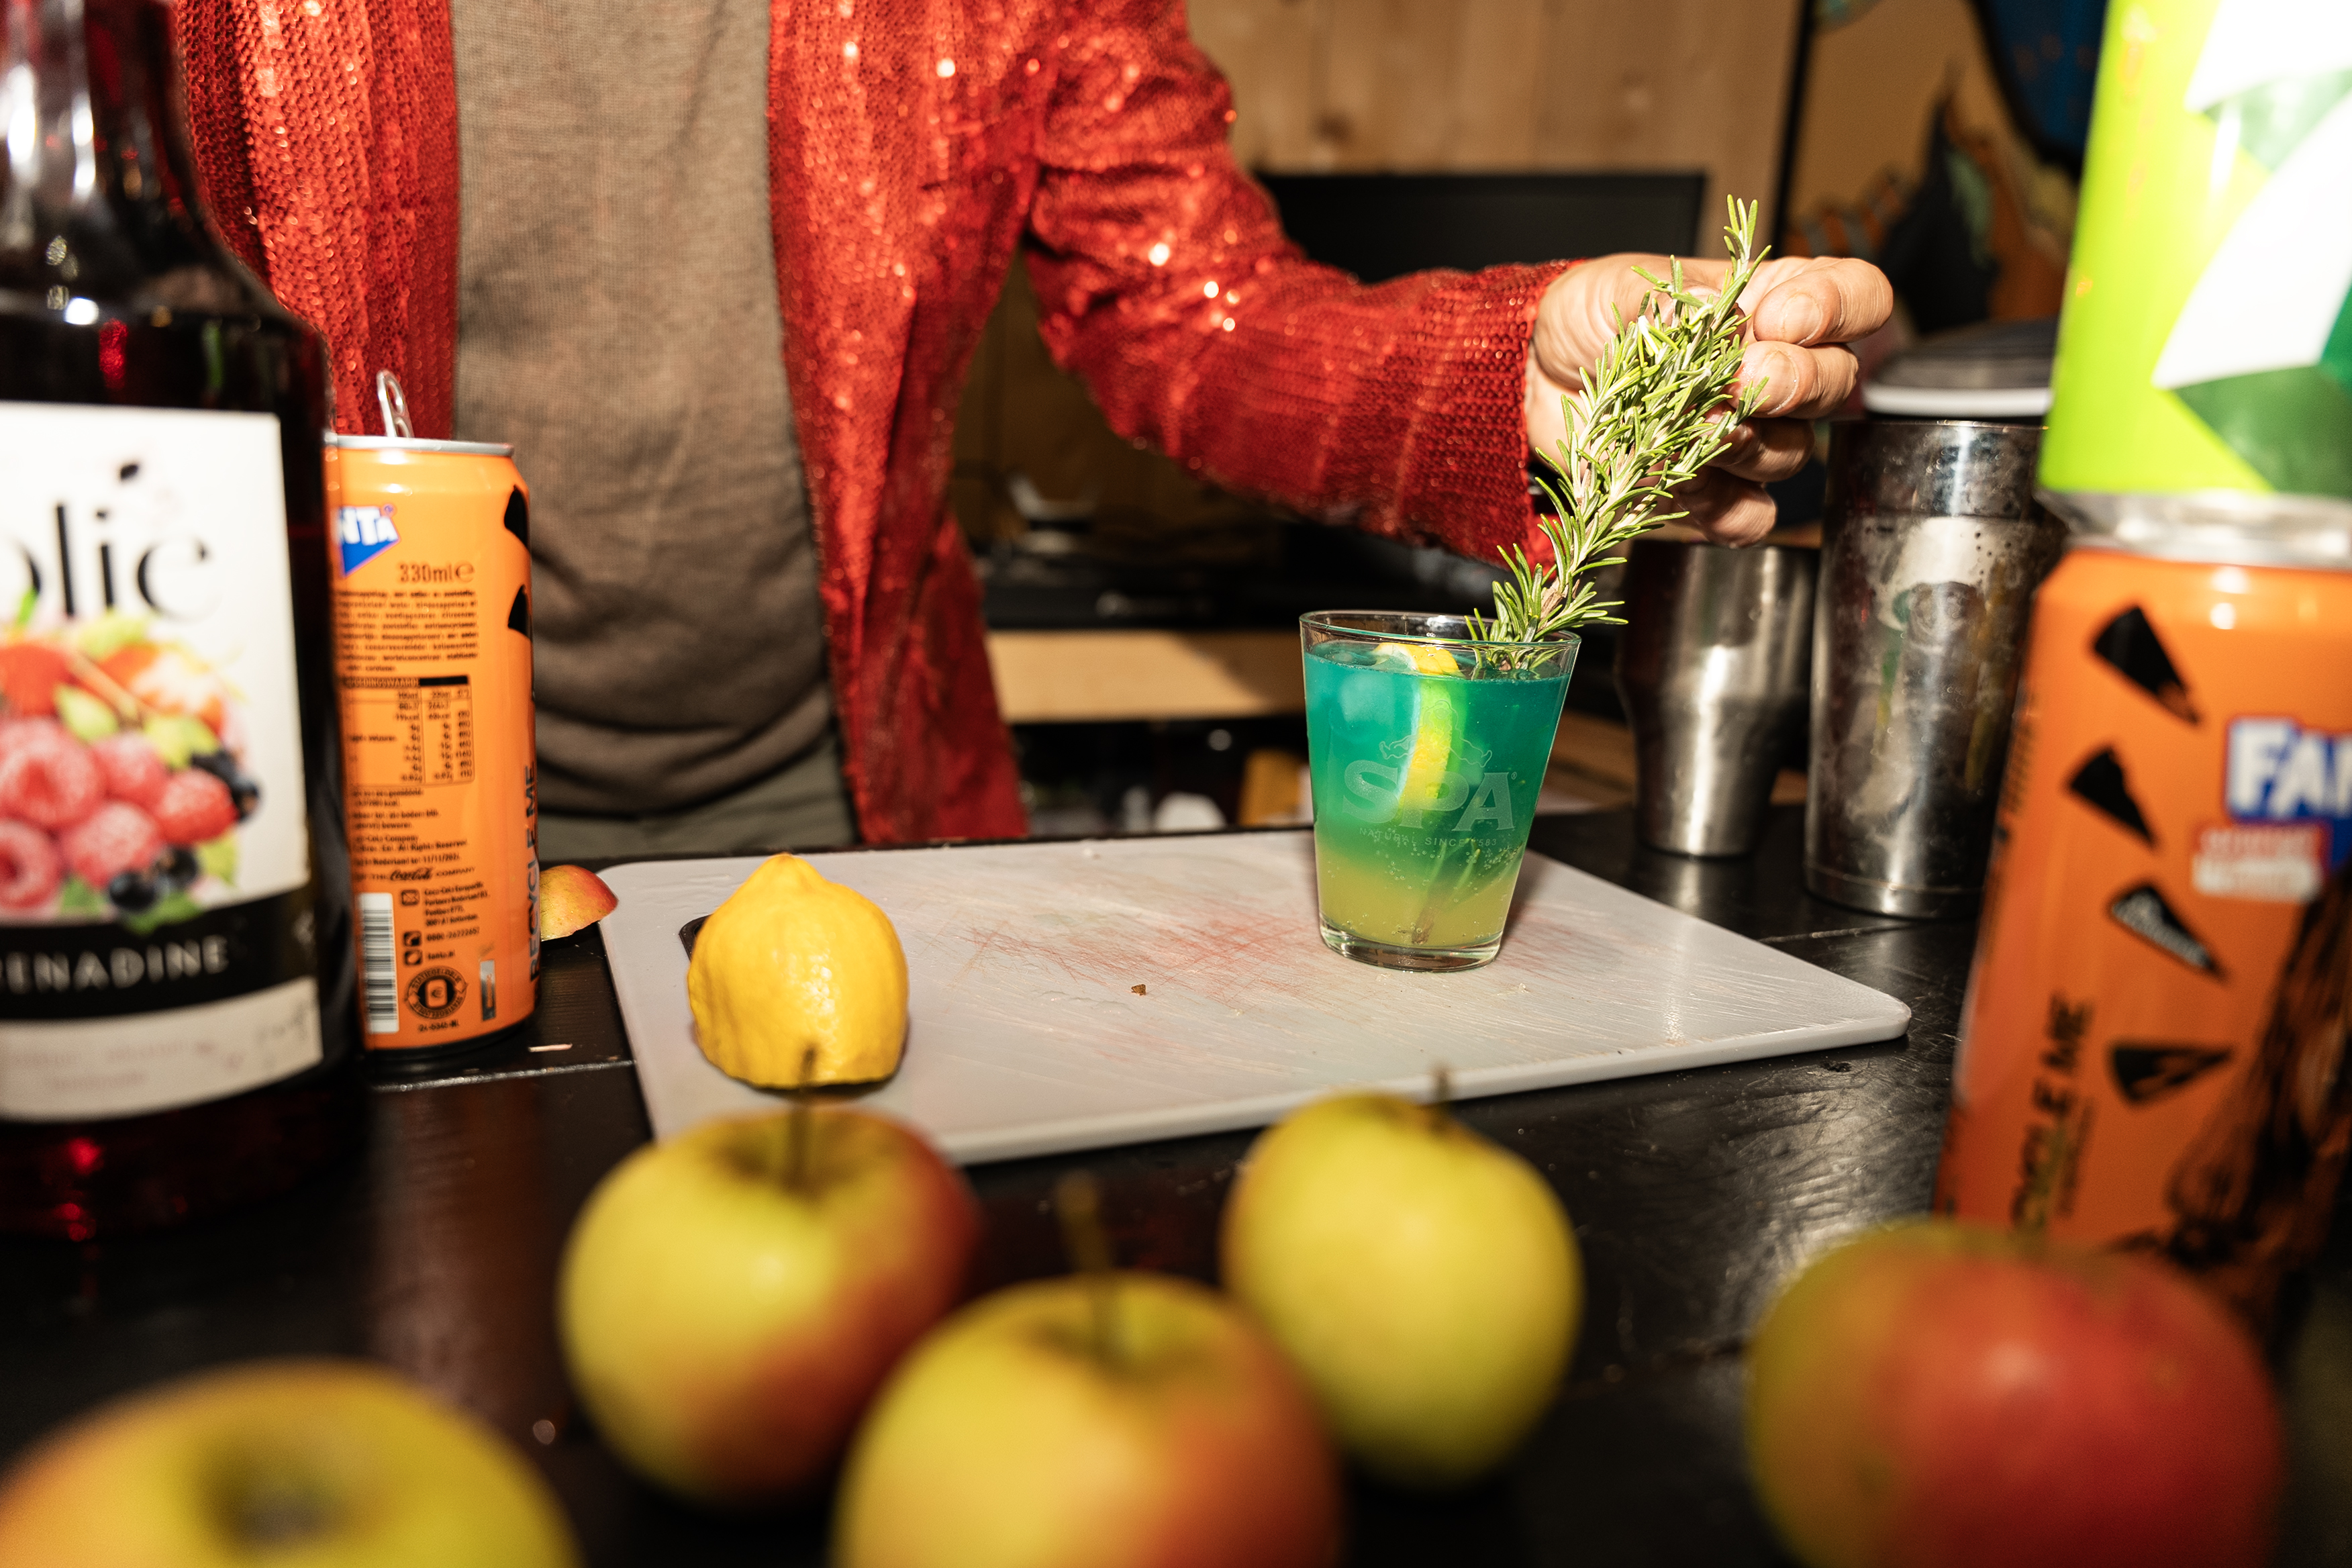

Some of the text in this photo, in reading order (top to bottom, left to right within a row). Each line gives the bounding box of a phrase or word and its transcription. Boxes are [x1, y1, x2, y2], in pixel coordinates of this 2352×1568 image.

[399, 563, 453, 583] 330ml
[1342, 759, 1515, 832] SPA
[1359, 828, 1497, 847] NATURAL SINCE 583
[0, 936, 229, 994] ENADINE
